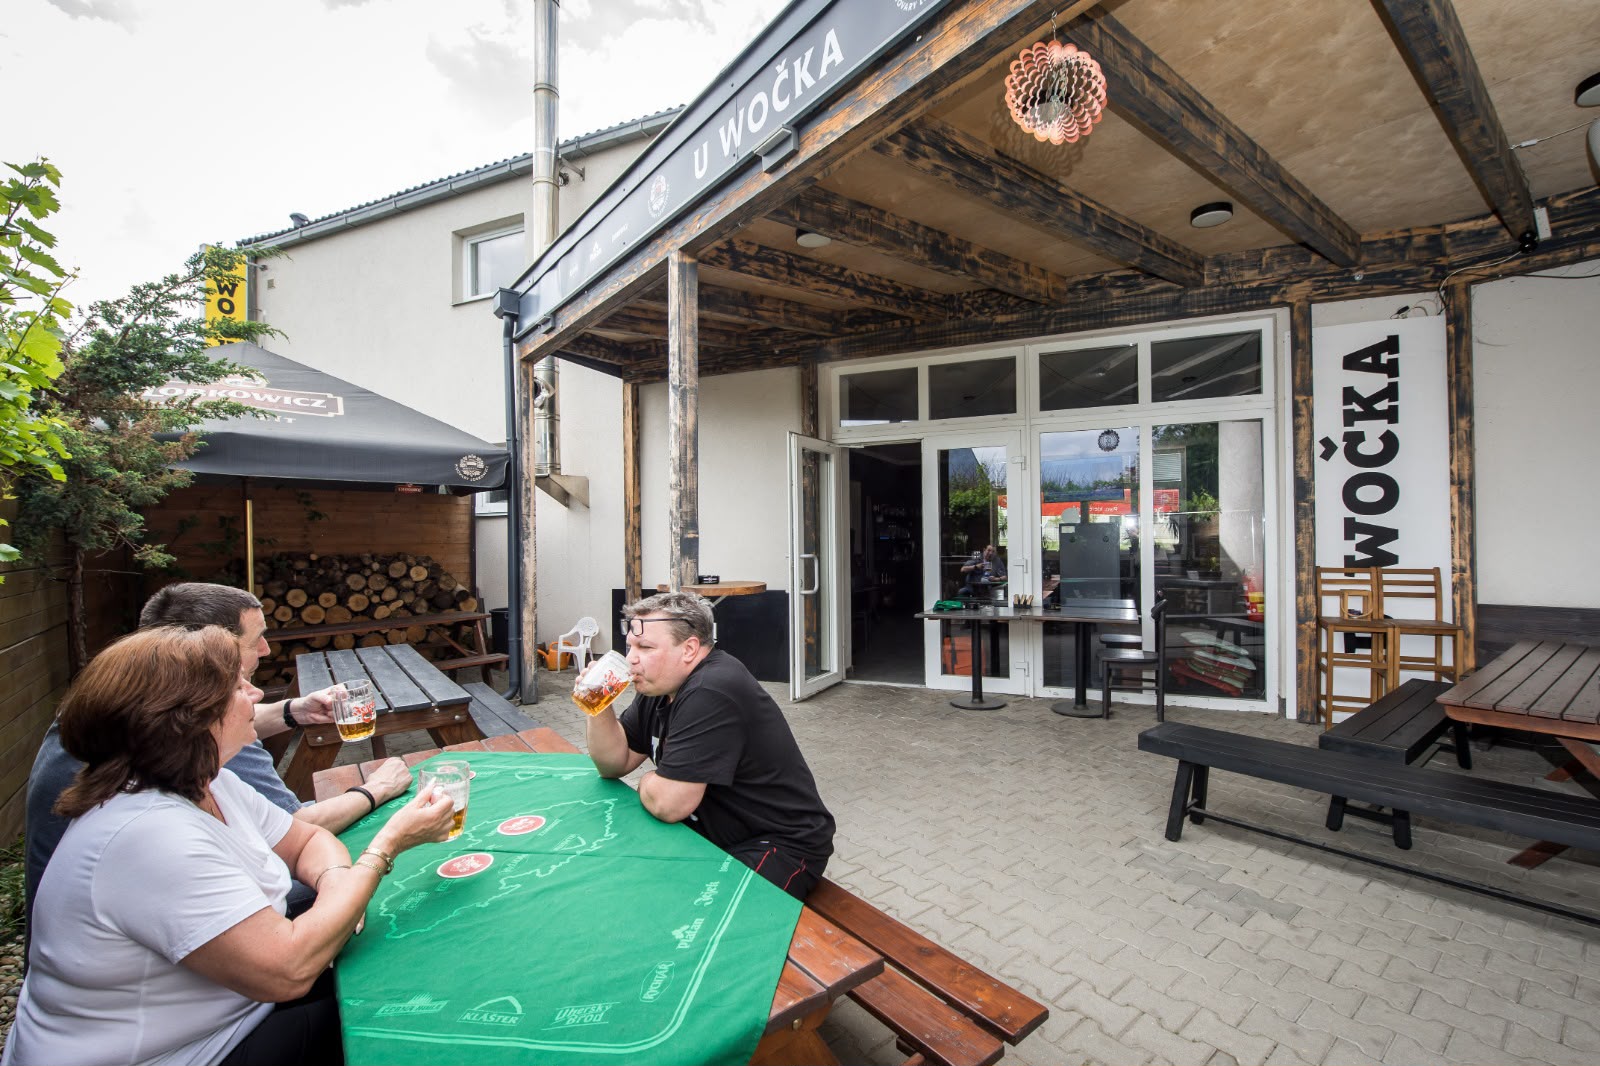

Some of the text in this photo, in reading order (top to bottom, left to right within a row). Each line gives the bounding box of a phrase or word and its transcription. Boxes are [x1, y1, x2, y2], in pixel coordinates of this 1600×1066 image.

[693, 28, 845, 180] U WOČKA
[1318, 334, 1400, 577] WOČKA
